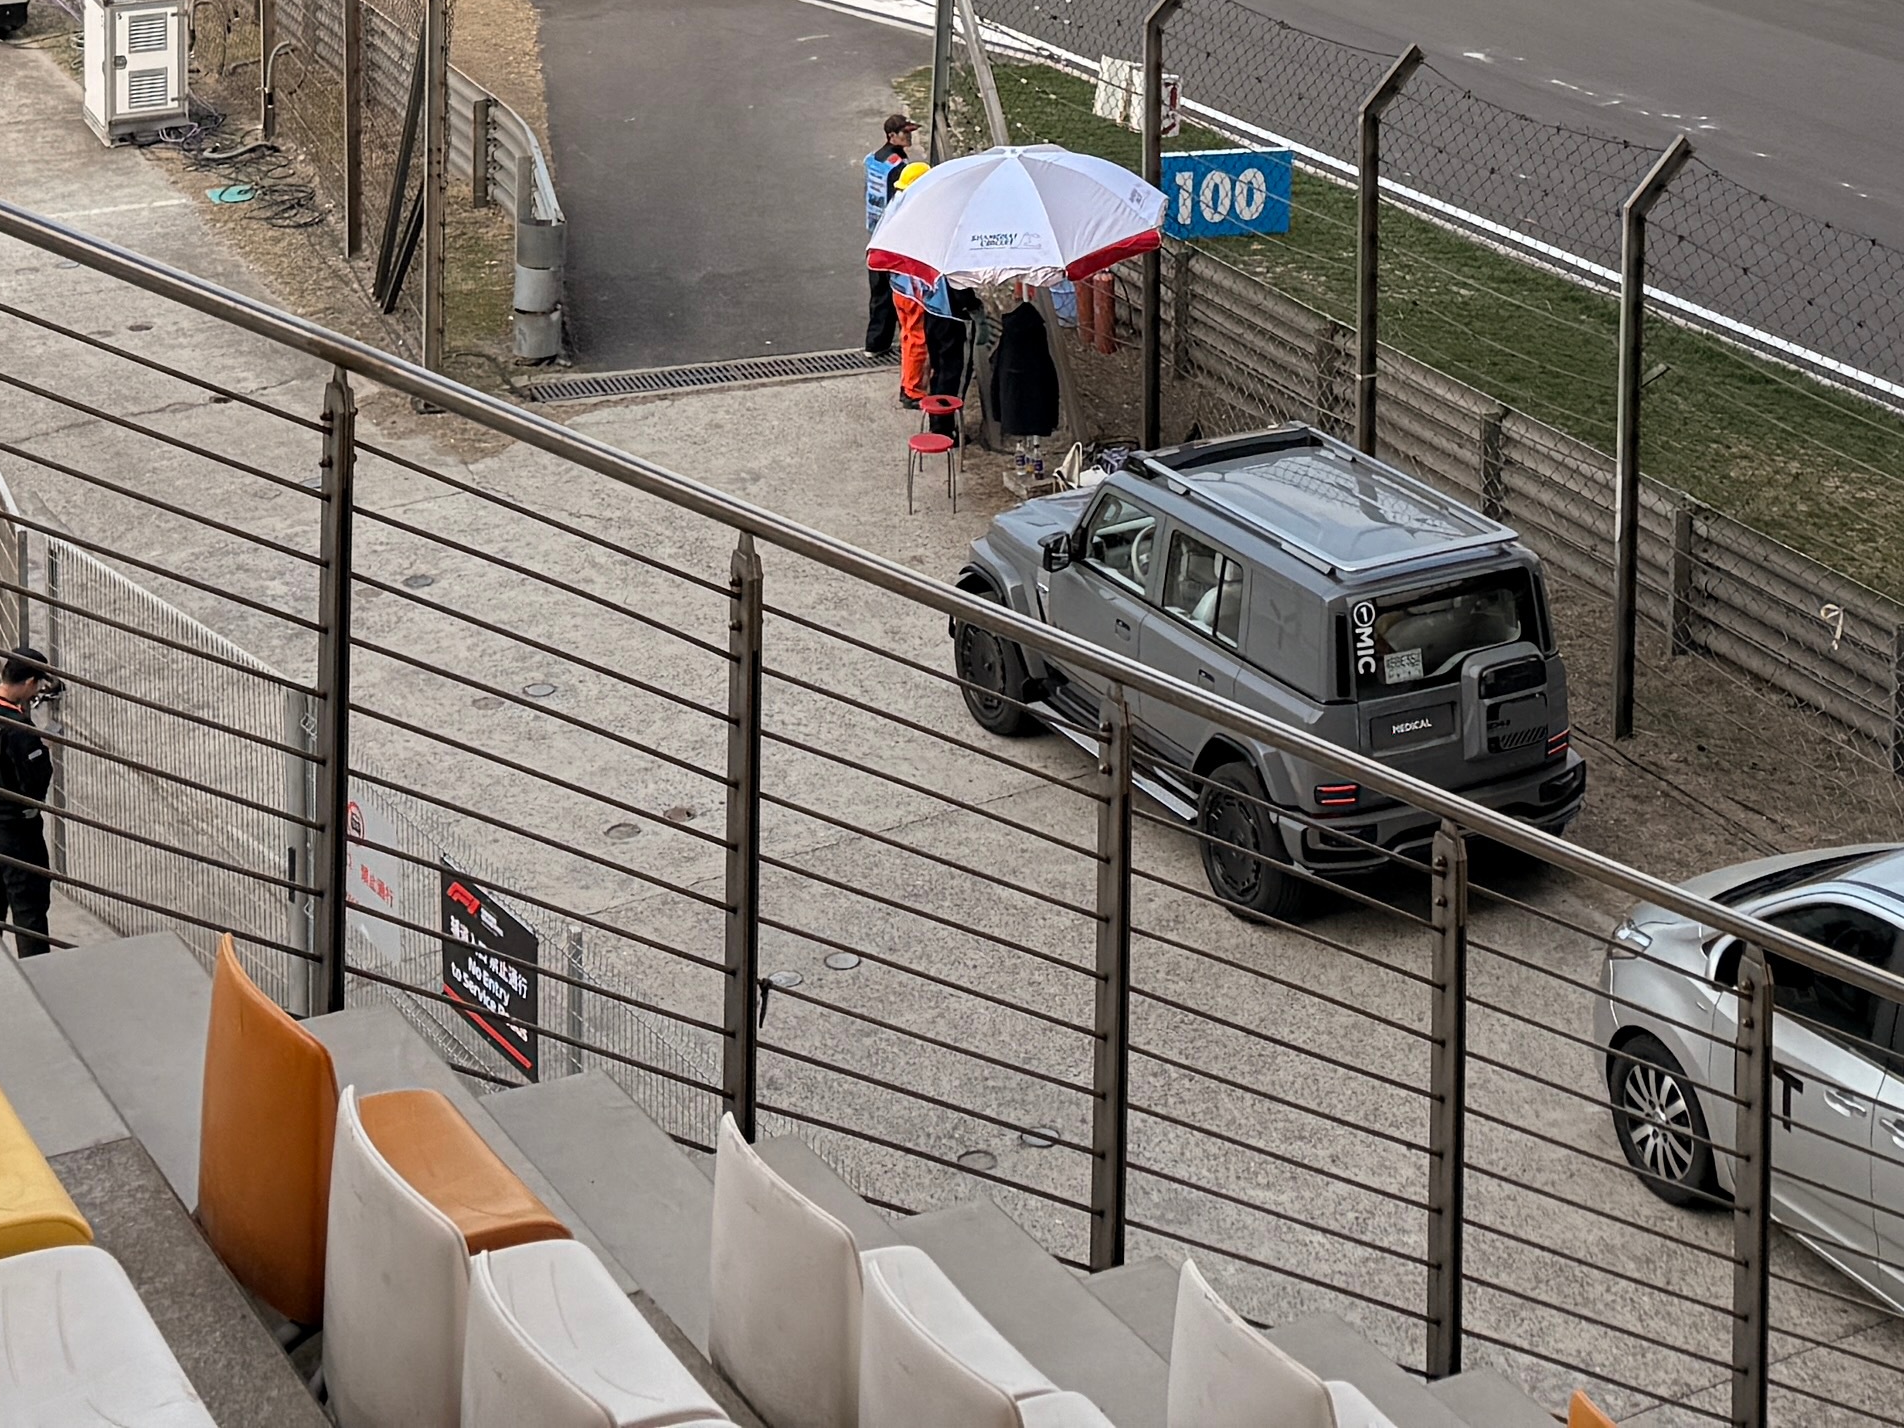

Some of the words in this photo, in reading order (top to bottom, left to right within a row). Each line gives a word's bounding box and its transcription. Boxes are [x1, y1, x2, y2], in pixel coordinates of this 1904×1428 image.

[1175, 167, 1266, 225] 100
[1355, 627, 1376, 675] MIC
[1392, 718, 1433, 735] MEDICAL
[451, 961, 462, 983] to
[463, 972, 497, 1014] Service
[468, 956, 481, 981] No
[482, 973, 510, 1007] Entry
